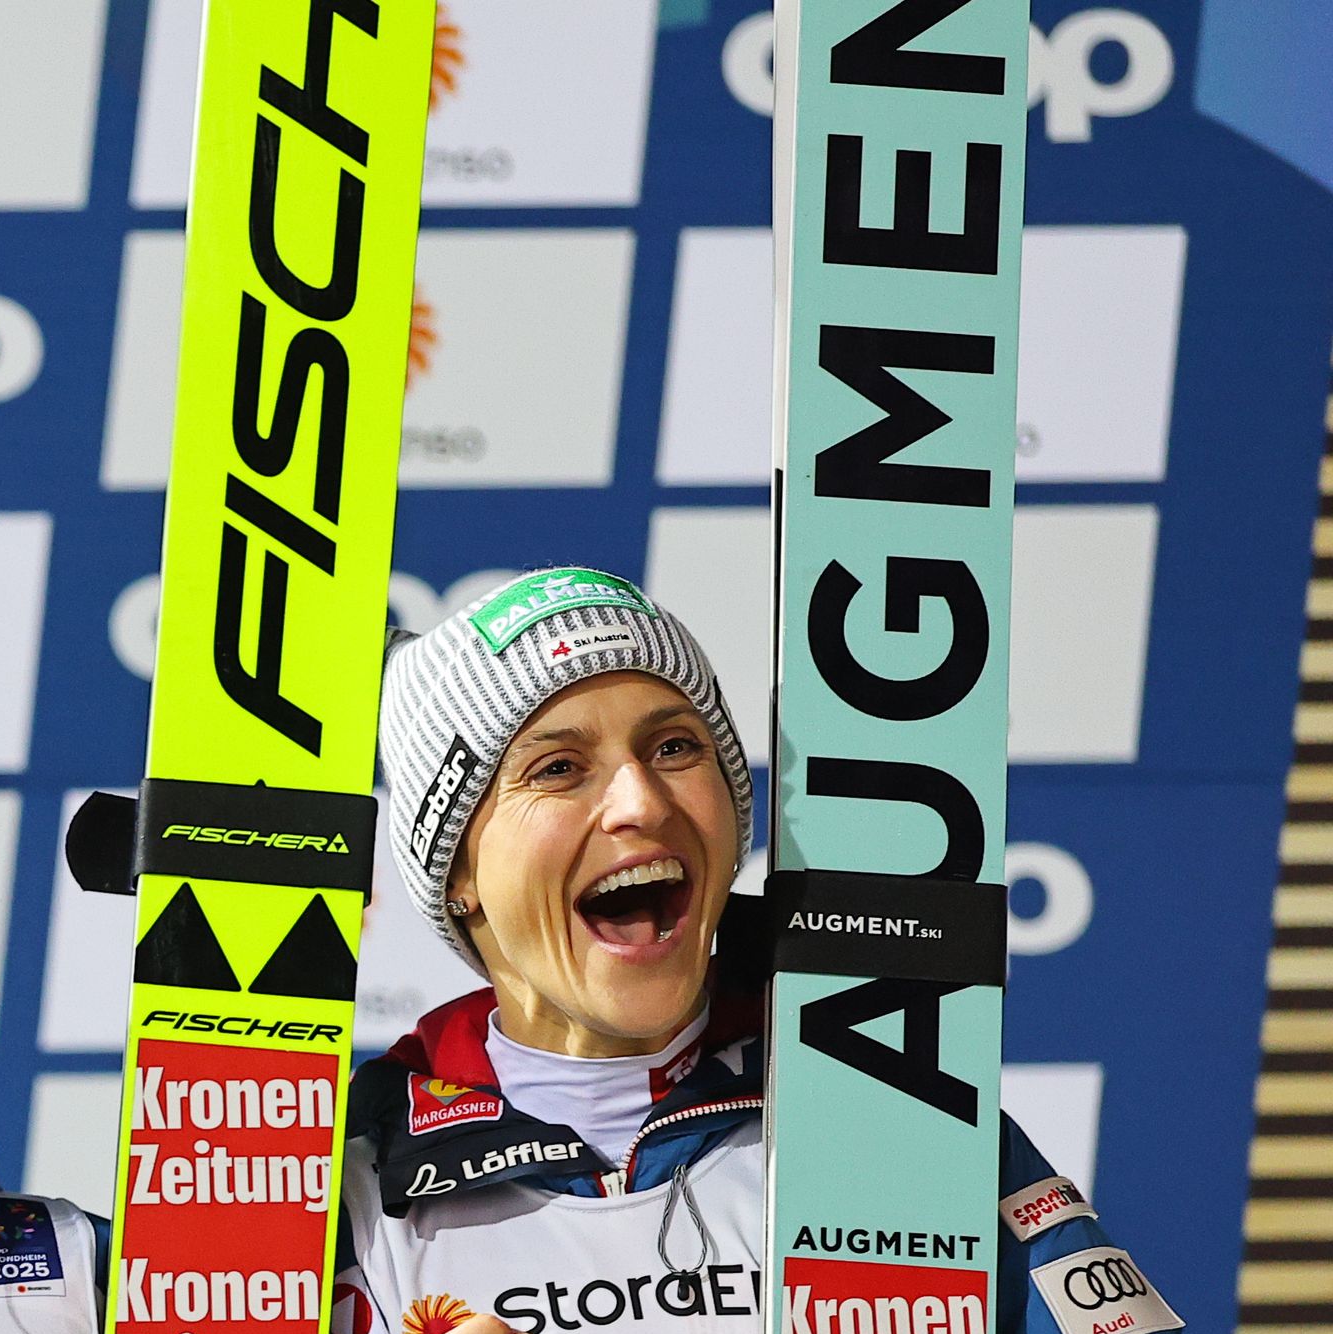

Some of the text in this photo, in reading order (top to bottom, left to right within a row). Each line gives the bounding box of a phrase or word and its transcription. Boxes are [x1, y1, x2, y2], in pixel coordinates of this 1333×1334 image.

[574, 632, 630, 648] Ski Austria
[412, 748, 467, 868] Eisbär
[161, 824, 328, 853] FISCHER
[788, 911, 943, 940] AUGMENT.SKI
[141, 1010, 344, 1043] FISCHER
[130, 1066, 335, 1130] Kronen
[413, 1100, 497, 1129] HARGASSNER
[129, 1139, 334, 1213] Zeitung
[461, 1141, 585, 1181] Löffler
[792, 1225, 981, 1261] AUGMENT
[115, 1257, 320, 1323] Kronen
